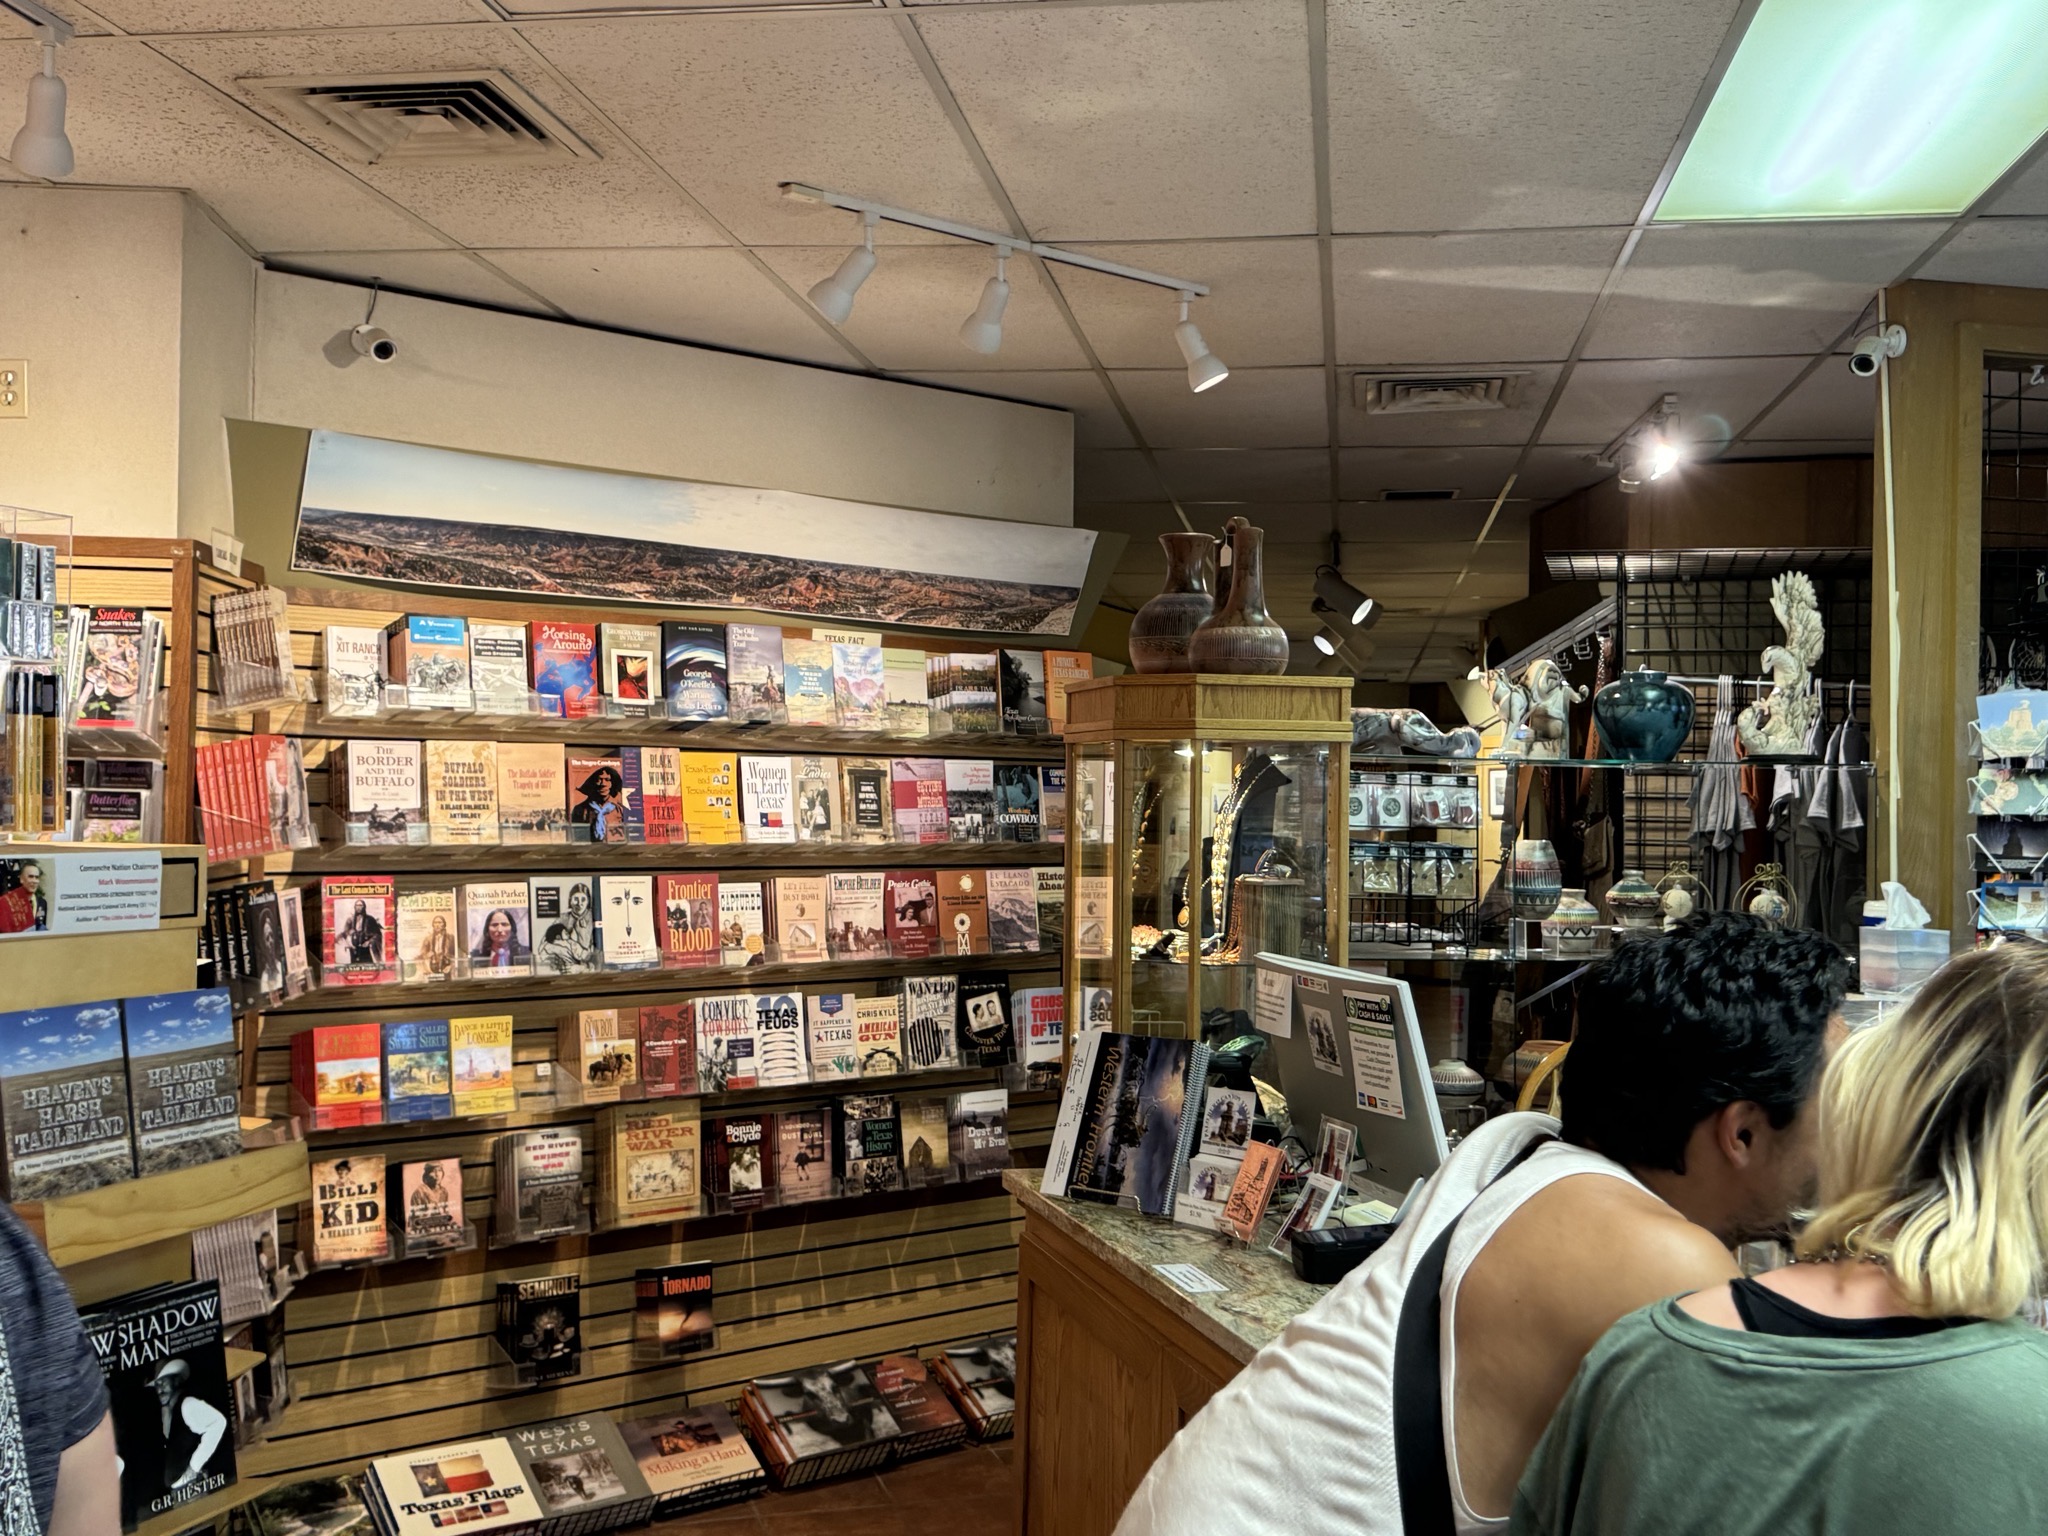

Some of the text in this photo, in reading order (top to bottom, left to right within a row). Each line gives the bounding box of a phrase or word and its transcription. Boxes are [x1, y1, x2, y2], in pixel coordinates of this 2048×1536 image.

[95, 608, 136, 621] Snakes
[541, 625, 586, 643] Horsing
[552, 638, 593, 651] Around
[683, 668, 712, 680] Georgia
[375, 745, 395, 755] THE
[356, 755, 414, 767] BORDER
[443, 761, 484, 775] BUFFALO
[580, 759, 596, 767] Negro
[649, 753, 673, 769] BLACK
[364, 767, 405, 775] AND THE
[507, 768, 518, 779] The
[747, 761, 787, 780] Women
[355, 775, 415, 787] BUFFALO
[442, 775, 486, 788] SOLDIERS
[648, 771, 676, 786] WOMEN
[746, 778, 789, 797] in Early
[89, 793, 138, 806] Butterflies
[436, 789, 494, 802] IN THE WEST
[754, 790, 784, 809] Texas
[651, 805, 676, 820] TEXAS
[999, 813, 1039, 824] COWBOY
[79, 864, 111, 872] Comanche
[834, 875, 882, 891] EMPIRE BUILDER
[990, 872, 1001, 880] EL
[990, 879, 1031, 888] ESTACADO
[1037, 872, 1065, 881] Histo
[330, 885, 341, 896] The
[351, 885, 375, 896] Comanche
[374, 885, 388, 896] Chief
[667, 879, 713, 901] Frontier
[887, 879, 911, 891] Prairie
[400, 895, 453, 908] EMPIRE
[467, 889, 527, 900] Quanah Parker,
[720, 892, 762, 912] CAPTURED
[467, 898, 527, 907] COMANCHE CHIEF
[670, 926, 714, 953] BLOOD
[908, 980, 956, 995] WANTED
[756, 995, 795, 1011] 10
[1031, 994, 1064, 1009] GHOS
[702, 999, 748, 1021] CONVICT
[756, 1007, 799, 1020] TEXAS
[856, 1008, 897, 1019] CHRIS KYLE
[1359, 1010, 1372, 1019] CASH
[1376, 1013, 1391, 1022] SAVE!
[702, 1018, 749, 1039] COWBOYS
[756, 1018, 799, 1031] FEUDS
[858, 1020, 898, 1034] AMERICAN
[1031, 1022, 1047, 1037] OF
[388, 1037, 418, 1051] SWEET
[419, 1035, 448, 1049] SHRUB
[467, 1030, 499, 1046] LONGER
[824, 1028, 852, 1043] TEXAS
[858, 1031, 897, 1044] GUN
[147, 1057, 226, 1088] HEAVEN'S
[1093, 1045, 1123, 1113] Western
[21, 1075, 112, 1110] HEAVEN'S
[161, 1078, 217, 1106] HARSH
[38, 1098, 102, 1129] HARSH
[141, 1094, 235, 1129] TABLELAND
[626, 1118, 670, 1131] RED
[725, 1121, 762, 1136] Bonnie
[865, 1119, 893, 1131] Women
[967, 1125, 1003, 1139] DUST IN
[14, 1115, 124, 1155] TABLELAND
[625, 1126, 695, 1142] RIVER
[732, 1130, 762, 1145] Clyde
[782, 1130, 823, 1141] DUST BOWL
[872, 1130, 894, 1142] Texas
[525, 1140, 578, 1152] RED RIVER
[625, 1139, 675, 1152] WAR
[865, 1141, 893, 1154] History
[973, 1136, 1007, 1150] MY EYES
[1076, 1119, 1104, 1193] Frontier
[318, 1180, 379, 1201] BILLY
[319, 1232, 325, 1240] A
[327, 1228, 362, 1239] READER'S
[518, 1276, 579, 1301] SEMINOLE
[661, 1274, 712, 1297] TORNADO
[118, 1295, 219, 1348] SHADOW
[120, 1334, 170, 1371] MAN
[523, 1434, 597, 1457] TEXAS
[646, 1444, 748, 1477] Making a Hand
[150, 1471, 226, 1513] G.R. HESTER
[400, 1484, 526, 1516] Texas Flags
